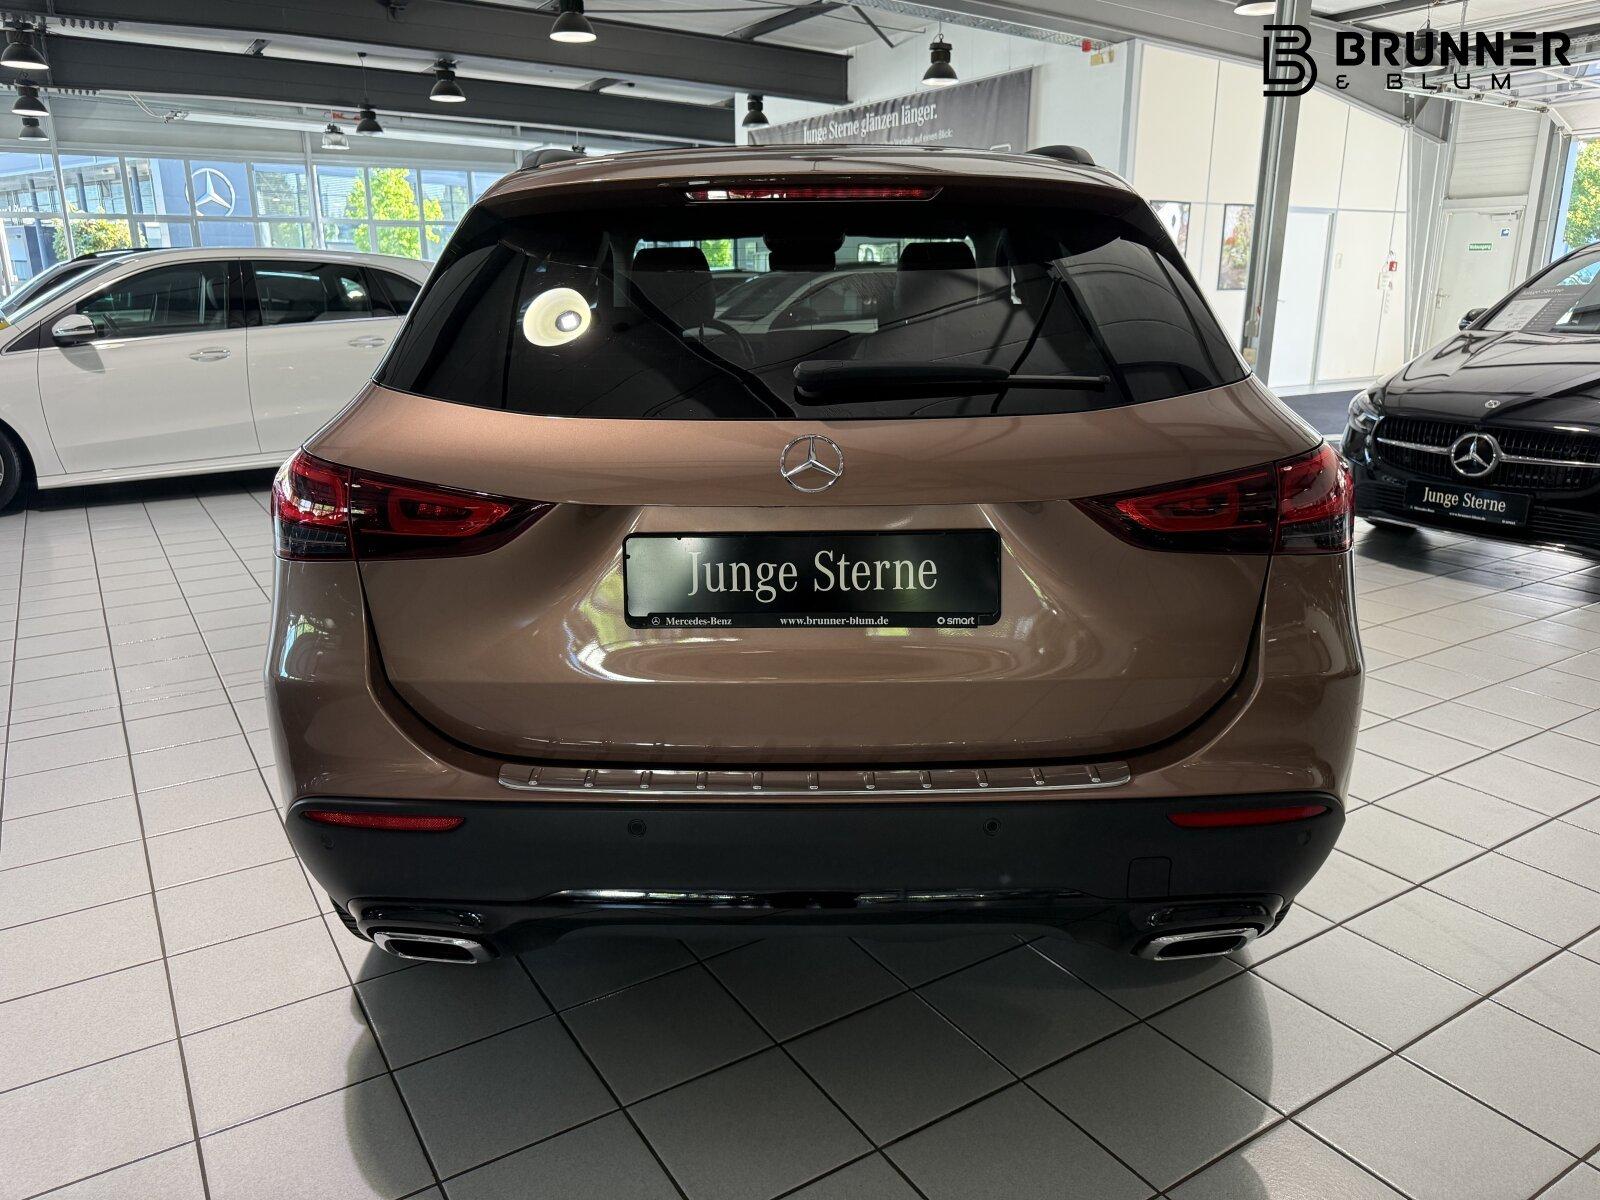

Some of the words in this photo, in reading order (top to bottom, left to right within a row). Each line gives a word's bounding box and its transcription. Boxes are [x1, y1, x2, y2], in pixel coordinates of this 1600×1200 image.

[803, 125, 828, 145] Junge
[828, 120, 860, 140] Sterne
[860, 111, 900, 138] glänzen
[901, 103, 938, 127] länger.
[1422, 486, 1459, 507] Junge
[1462, 492, 1506, 513] Sterne
[688, 550, 798, 603] Junge
[813, 549, 938, 592] Sterne
[665, 616, 733, 626] Mercedes-Benz
[779, 615, 889, 626] www.brunner-blum.de
[946, 616, 975, 625] smart
